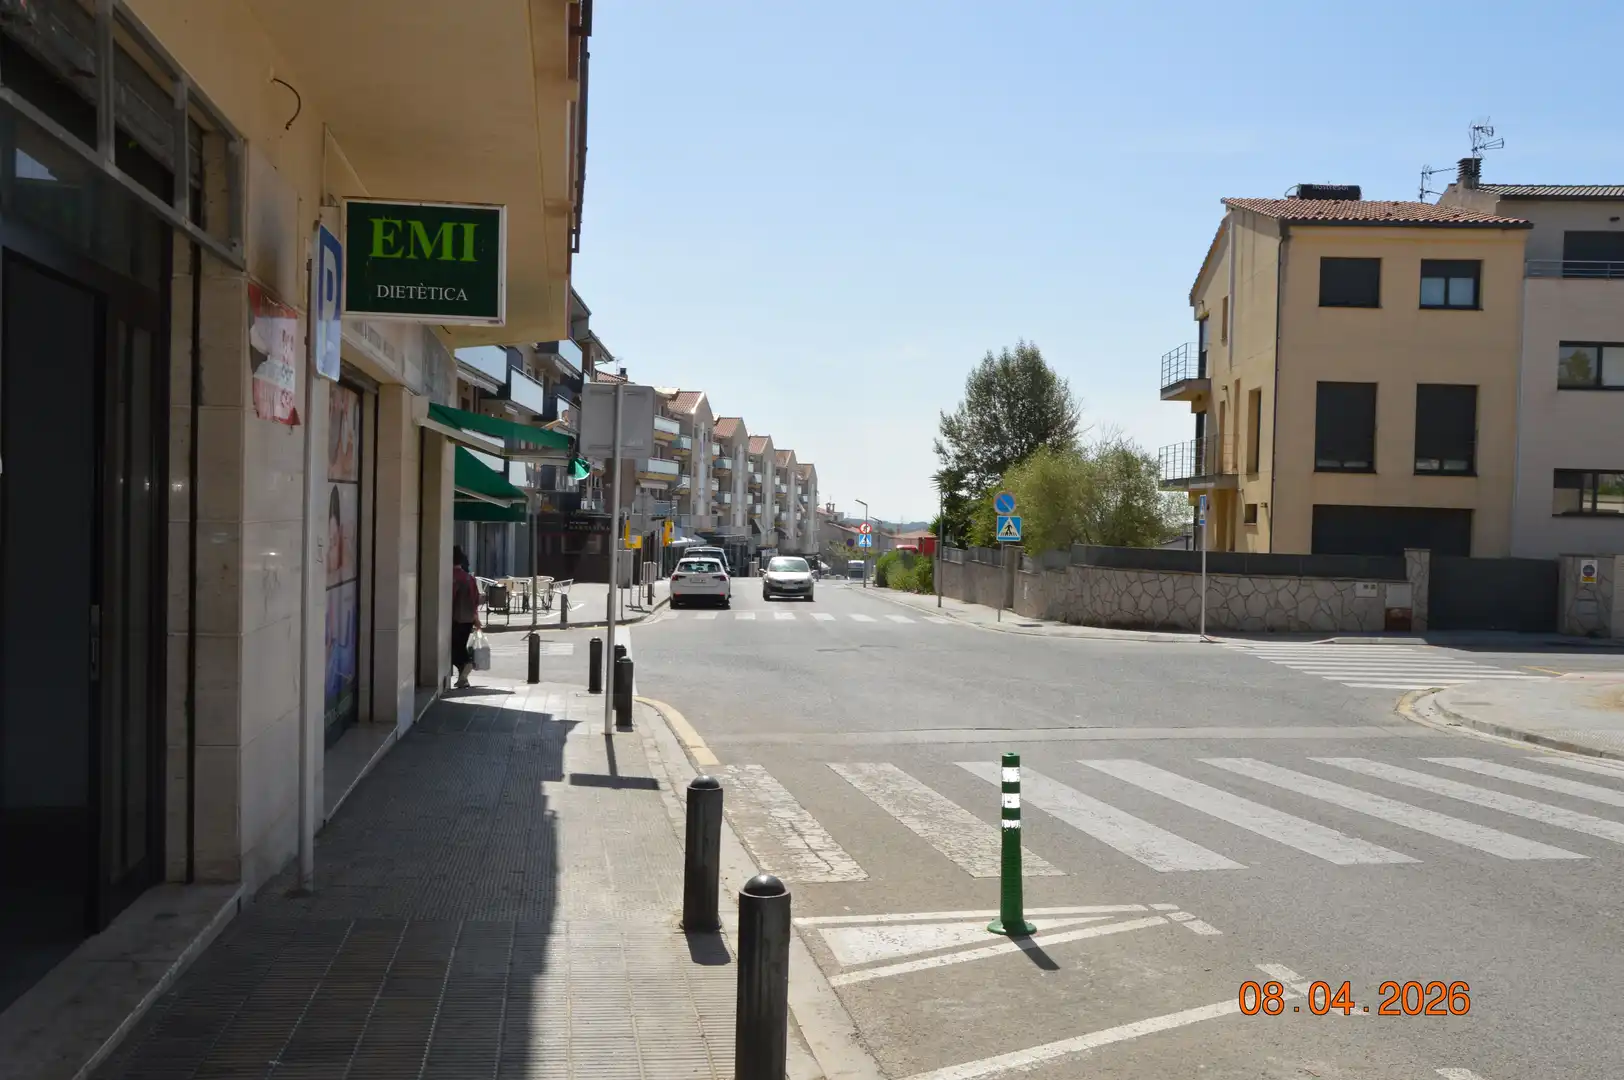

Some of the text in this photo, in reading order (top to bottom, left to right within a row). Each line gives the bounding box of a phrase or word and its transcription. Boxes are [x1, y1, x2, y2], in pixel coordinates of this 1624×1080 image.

[368, 217, 479, 262] EMI
[322, 245, 338, 356] P
[376, 283, 468, 301] DIETÈTICA
